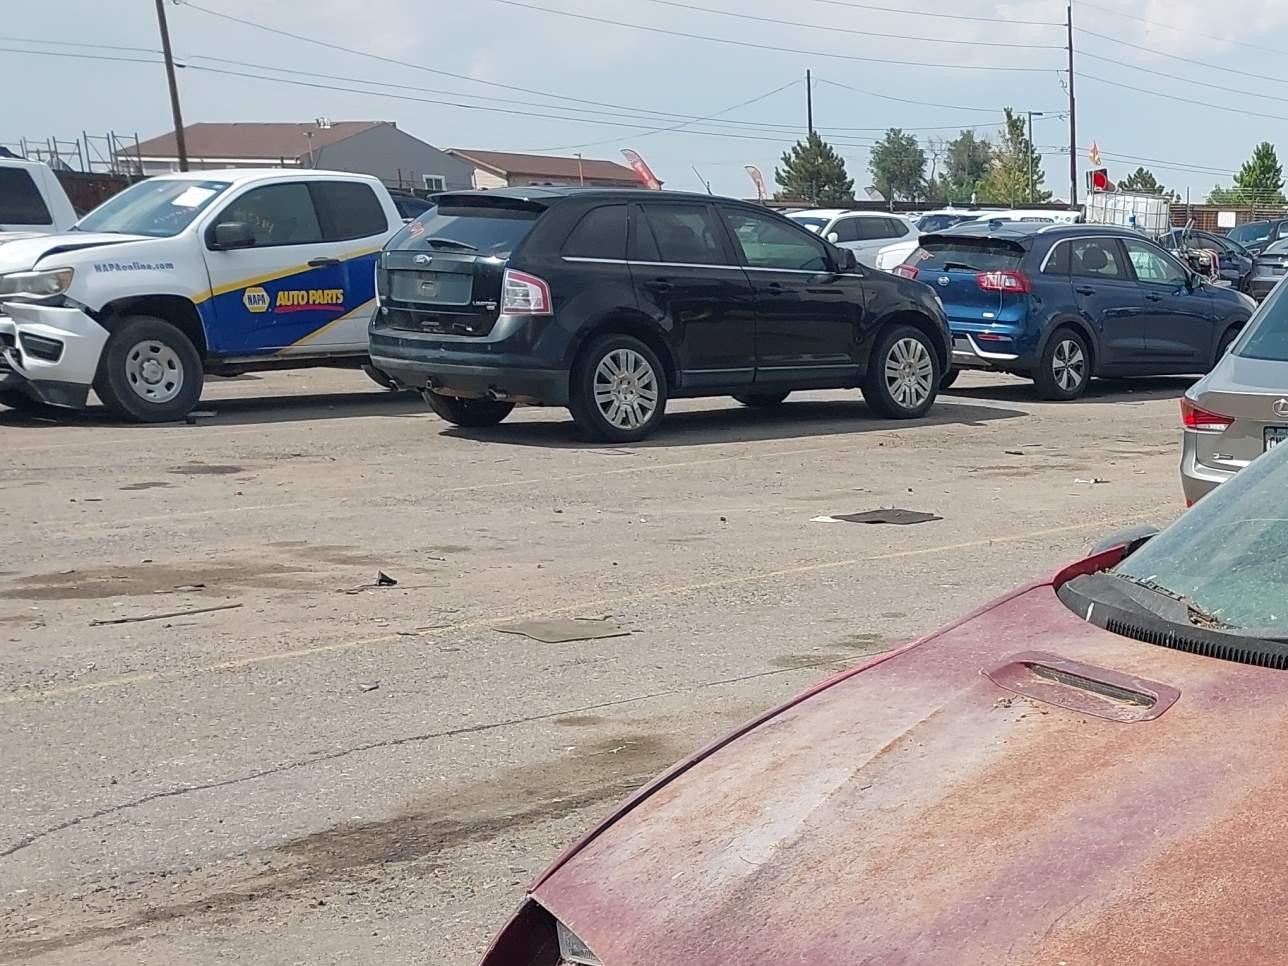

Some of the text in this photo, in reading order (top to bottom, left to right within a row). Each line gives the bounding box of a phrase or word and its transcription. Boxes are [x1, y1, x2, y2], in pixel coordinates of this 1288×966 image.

[94, 261, 175, 272] NAPAonline.com
[247, 293, 266, 306] NAPA
[276, 289, 344, 306] AUTO PARTS
